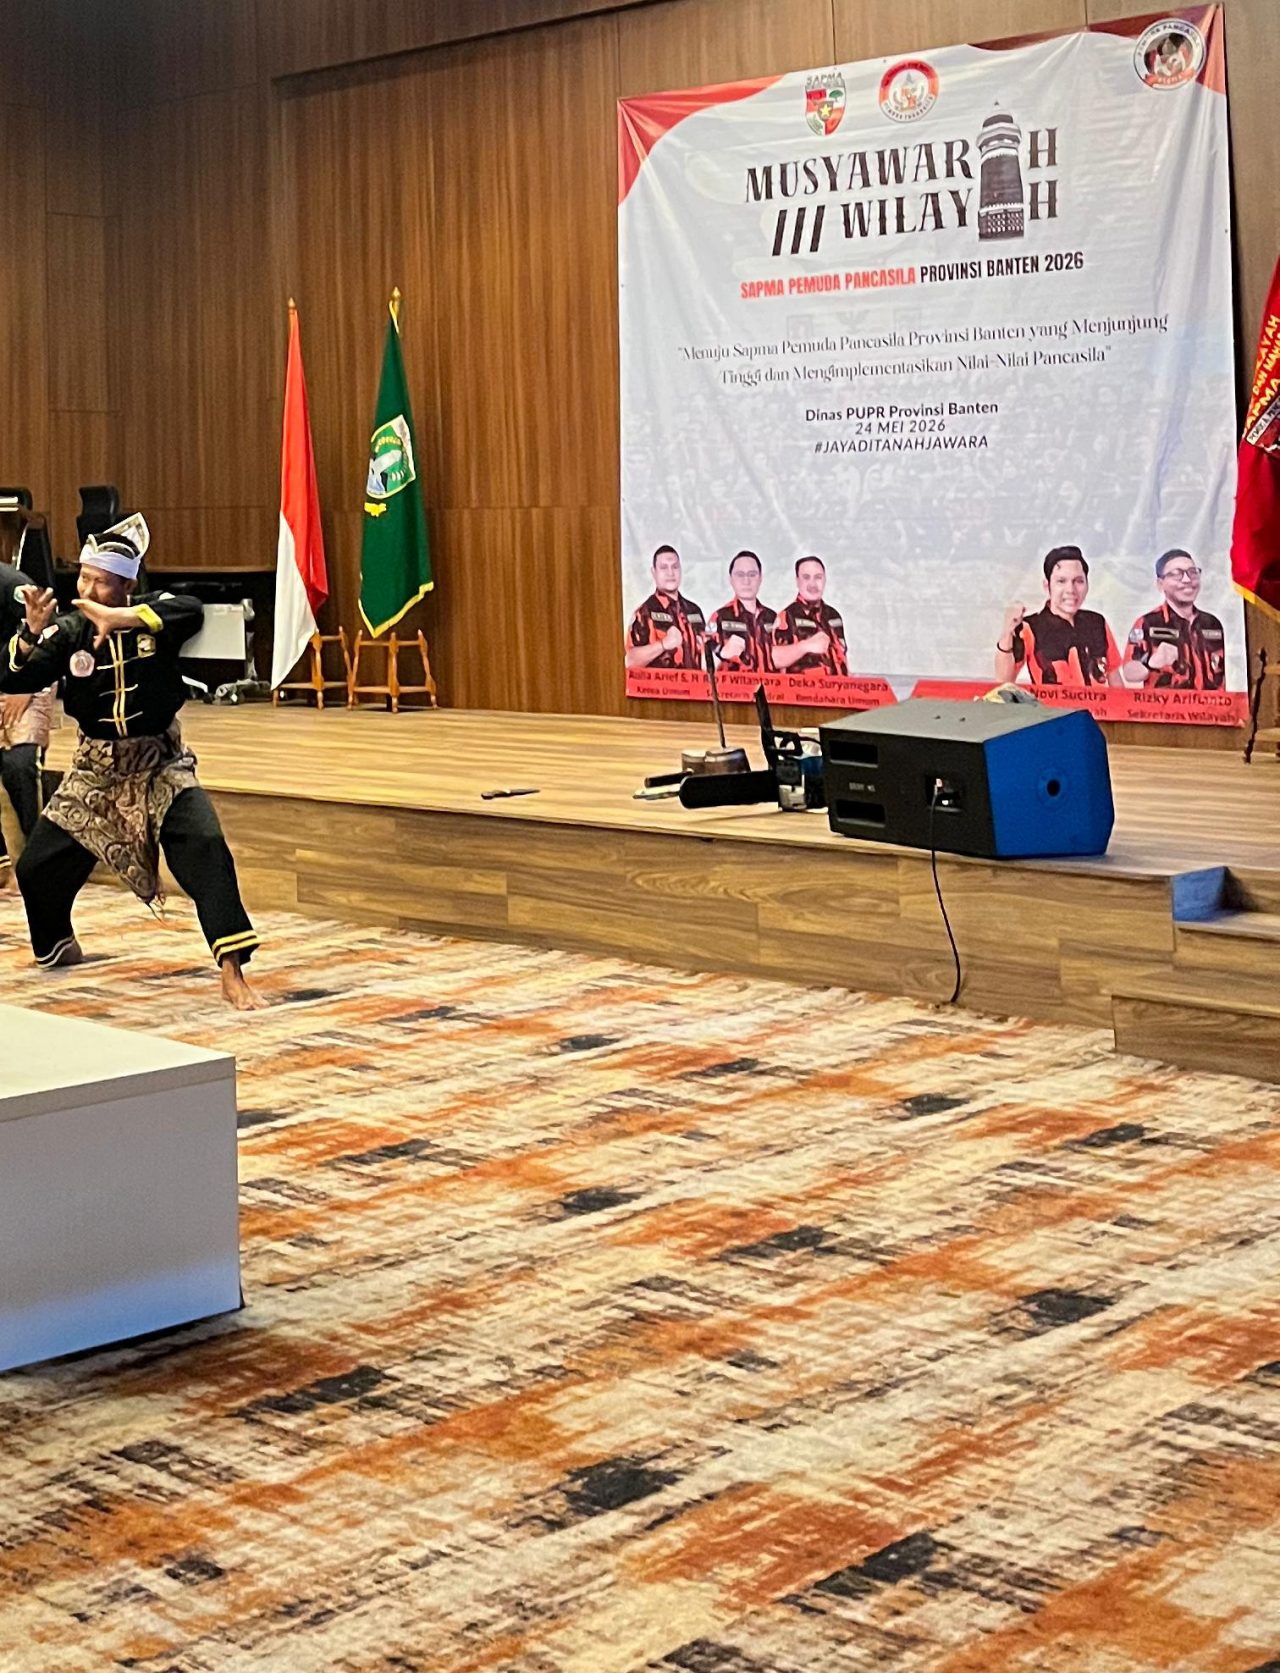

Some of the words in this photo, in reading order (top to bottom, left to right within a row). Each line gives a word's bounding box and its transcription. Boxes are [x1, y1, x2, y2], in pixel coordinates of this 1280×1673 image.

[806, 71, 843, 88] SAPMA
[740, 278, 784, 299] SAPMA
[788, 274, 840, 295] PEMUDA
[845, 267, 915, 289] PANCASILA
[920, 261, 981, 283] PROVINSI
[987, 256, 1039, 277] BANTEN
[1044, 252, 1084, 272] 2026
[733, 343, 778, 360] Sapma
[782, 337, 836, 354] Pemuda
[840, 332, 905, 351] Pancasila
[909, 328, 969, 346] Provinsi
[974, 327, 1025, 342] Banten
[1028, 321, 1068, 341] yang
[1072, 314, 1169, 336] Menjunjung
[722, 368, 762, 387] Tinggi
[765, 367, 789, 382] dan
[793, 357, 953, 382] Mengimplementasikan
[957, 350, 1029, 371] Nilai-Nilai
[806, 409, 842, 422] Dinas
[846, 407, 885, 420] PUPR
[889, 404, 944, 419] Provinsi
[948, 402, 998, 416] Banten
[855, 422, 872, 435] 24
[877, 420, 904, 434] MEI
[909, 419, 946, 433] 2026
[814, 435, 988, 454] #JAYADITANAHJAWARA
[789, 677, 815, 687] Deka
[819, 678, 888, 693] Suryanegara
[1061, 688, 1107, 701] Sucitra
[1134, 691, 1169, 706] Rizky
